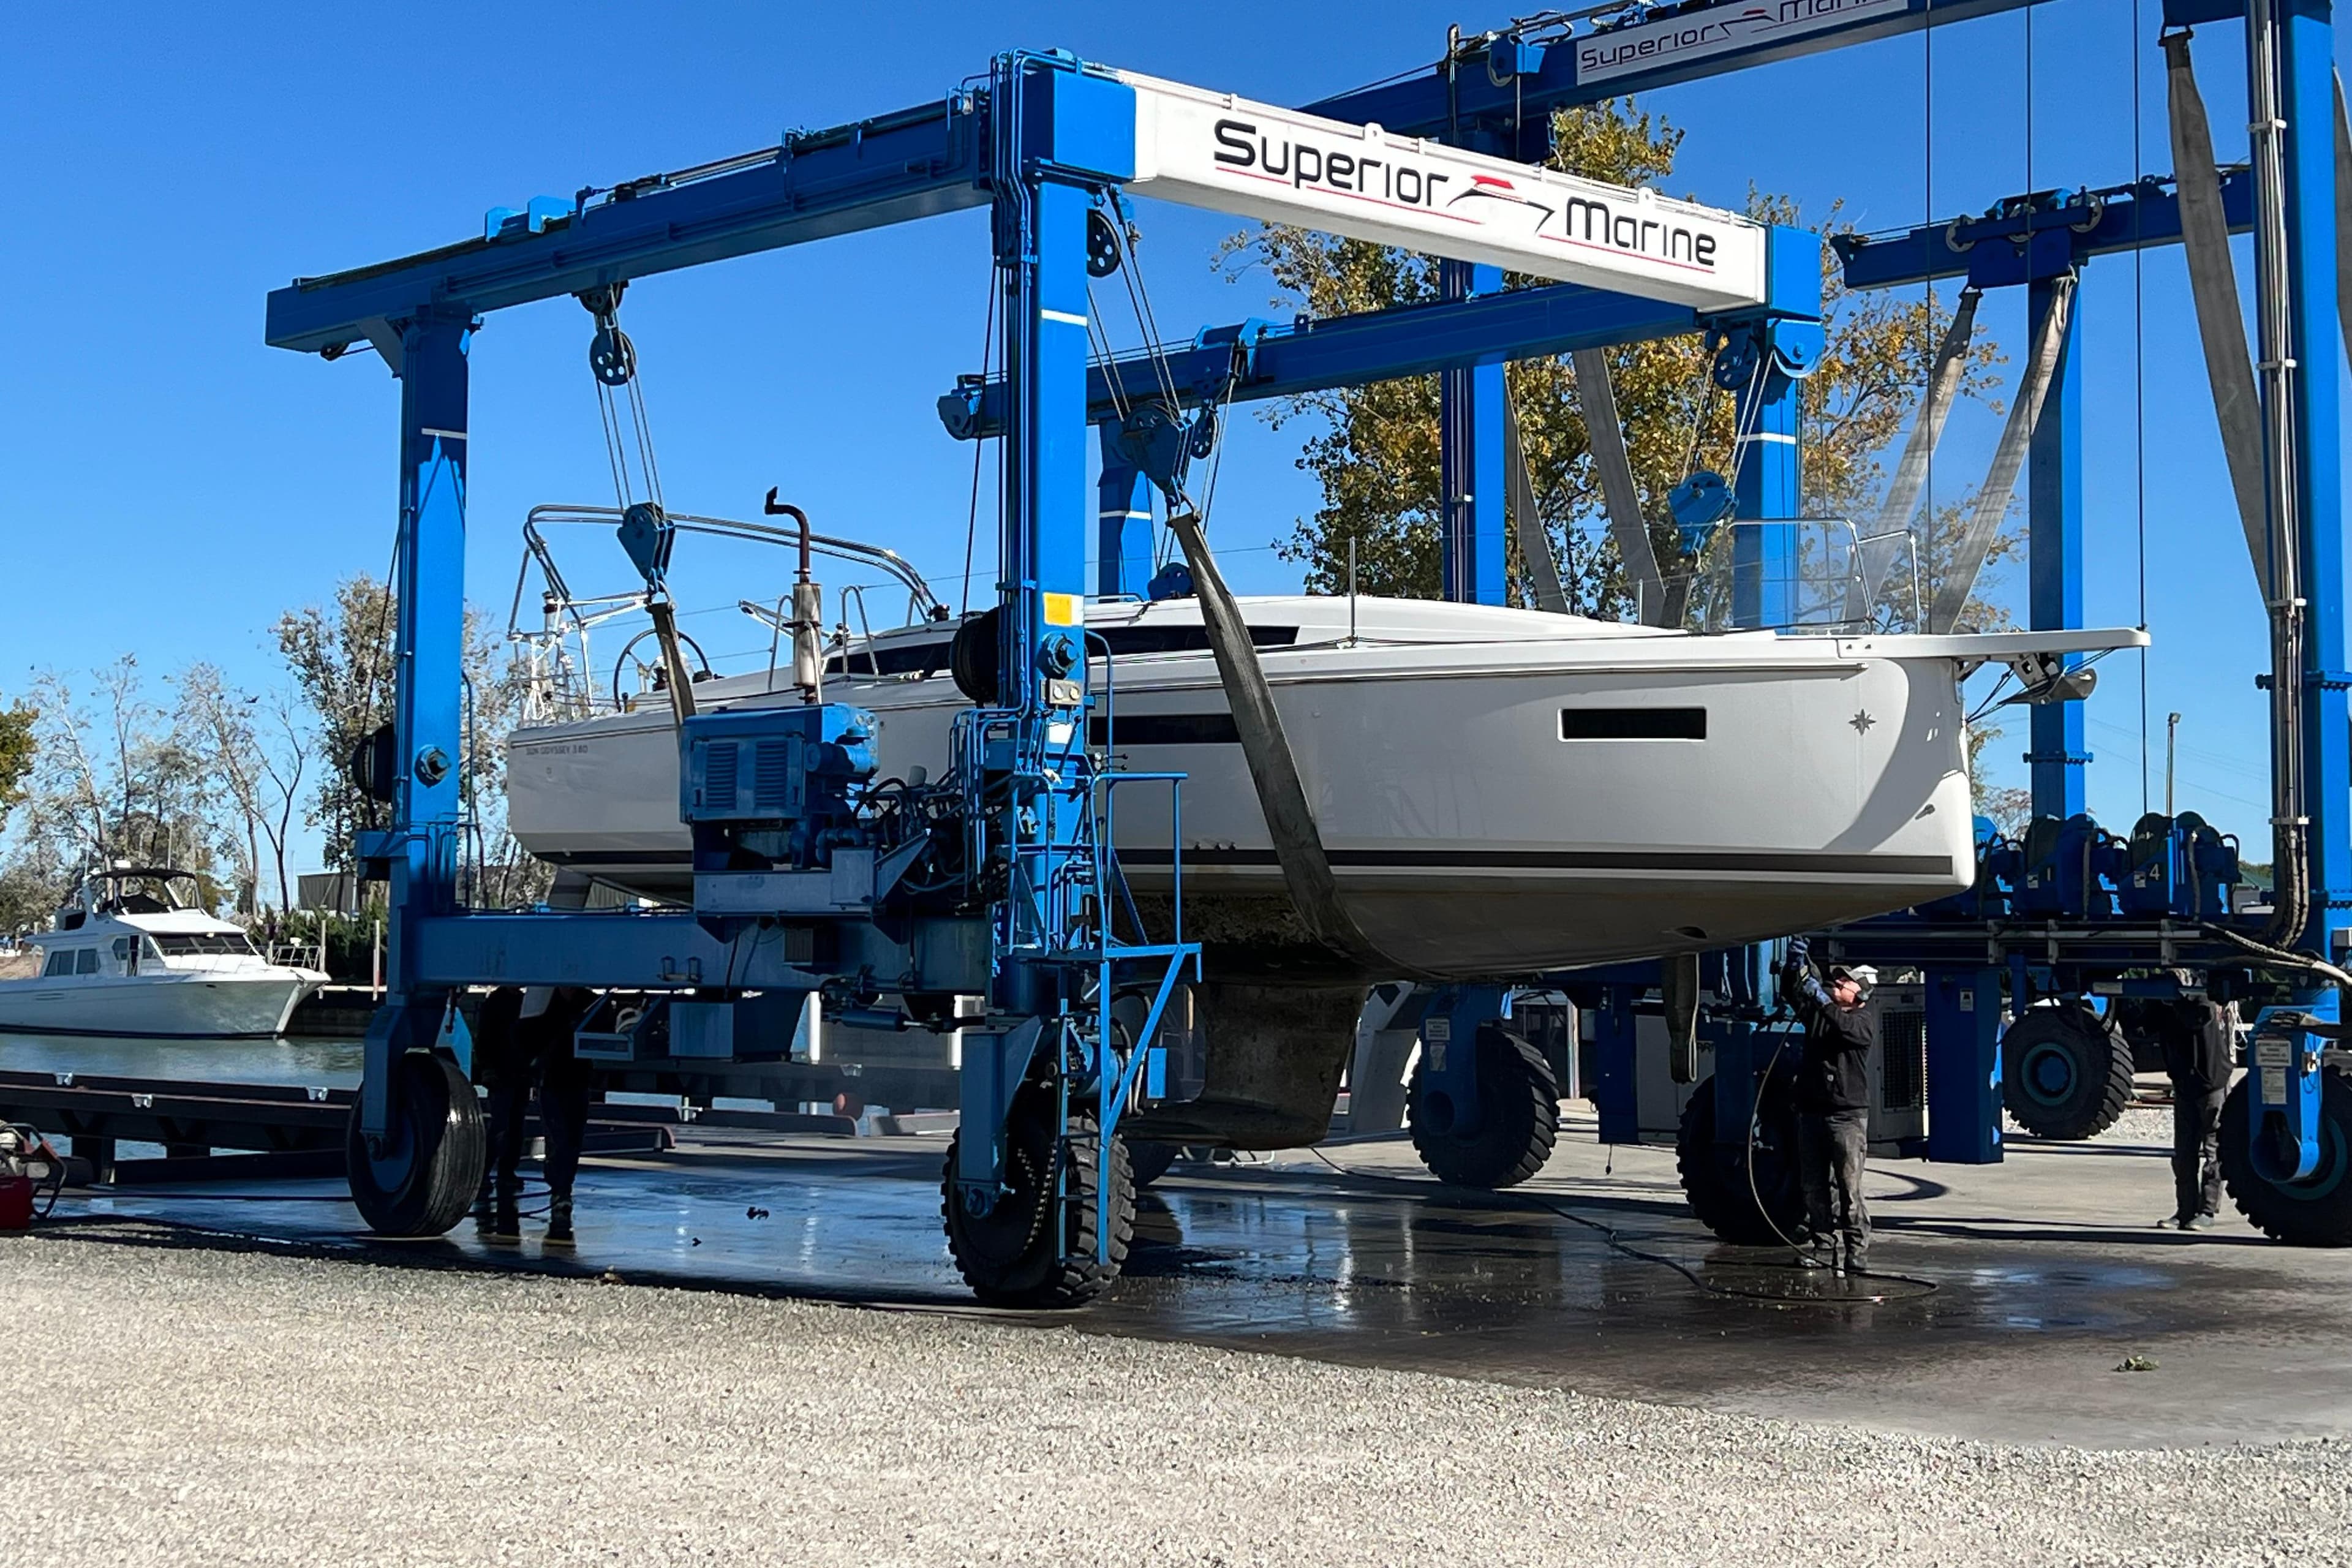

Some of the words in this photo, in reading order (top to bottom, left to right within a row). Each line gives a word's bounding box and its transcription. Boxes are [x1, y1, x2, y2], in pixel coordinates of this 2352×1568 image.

[1581, 24, 1714, 69] Superior
[1214, 119, 1449, 206] Superior
[1566, 196, 1716, 266] Marine
[2149, 862, 2161, 881] 4
